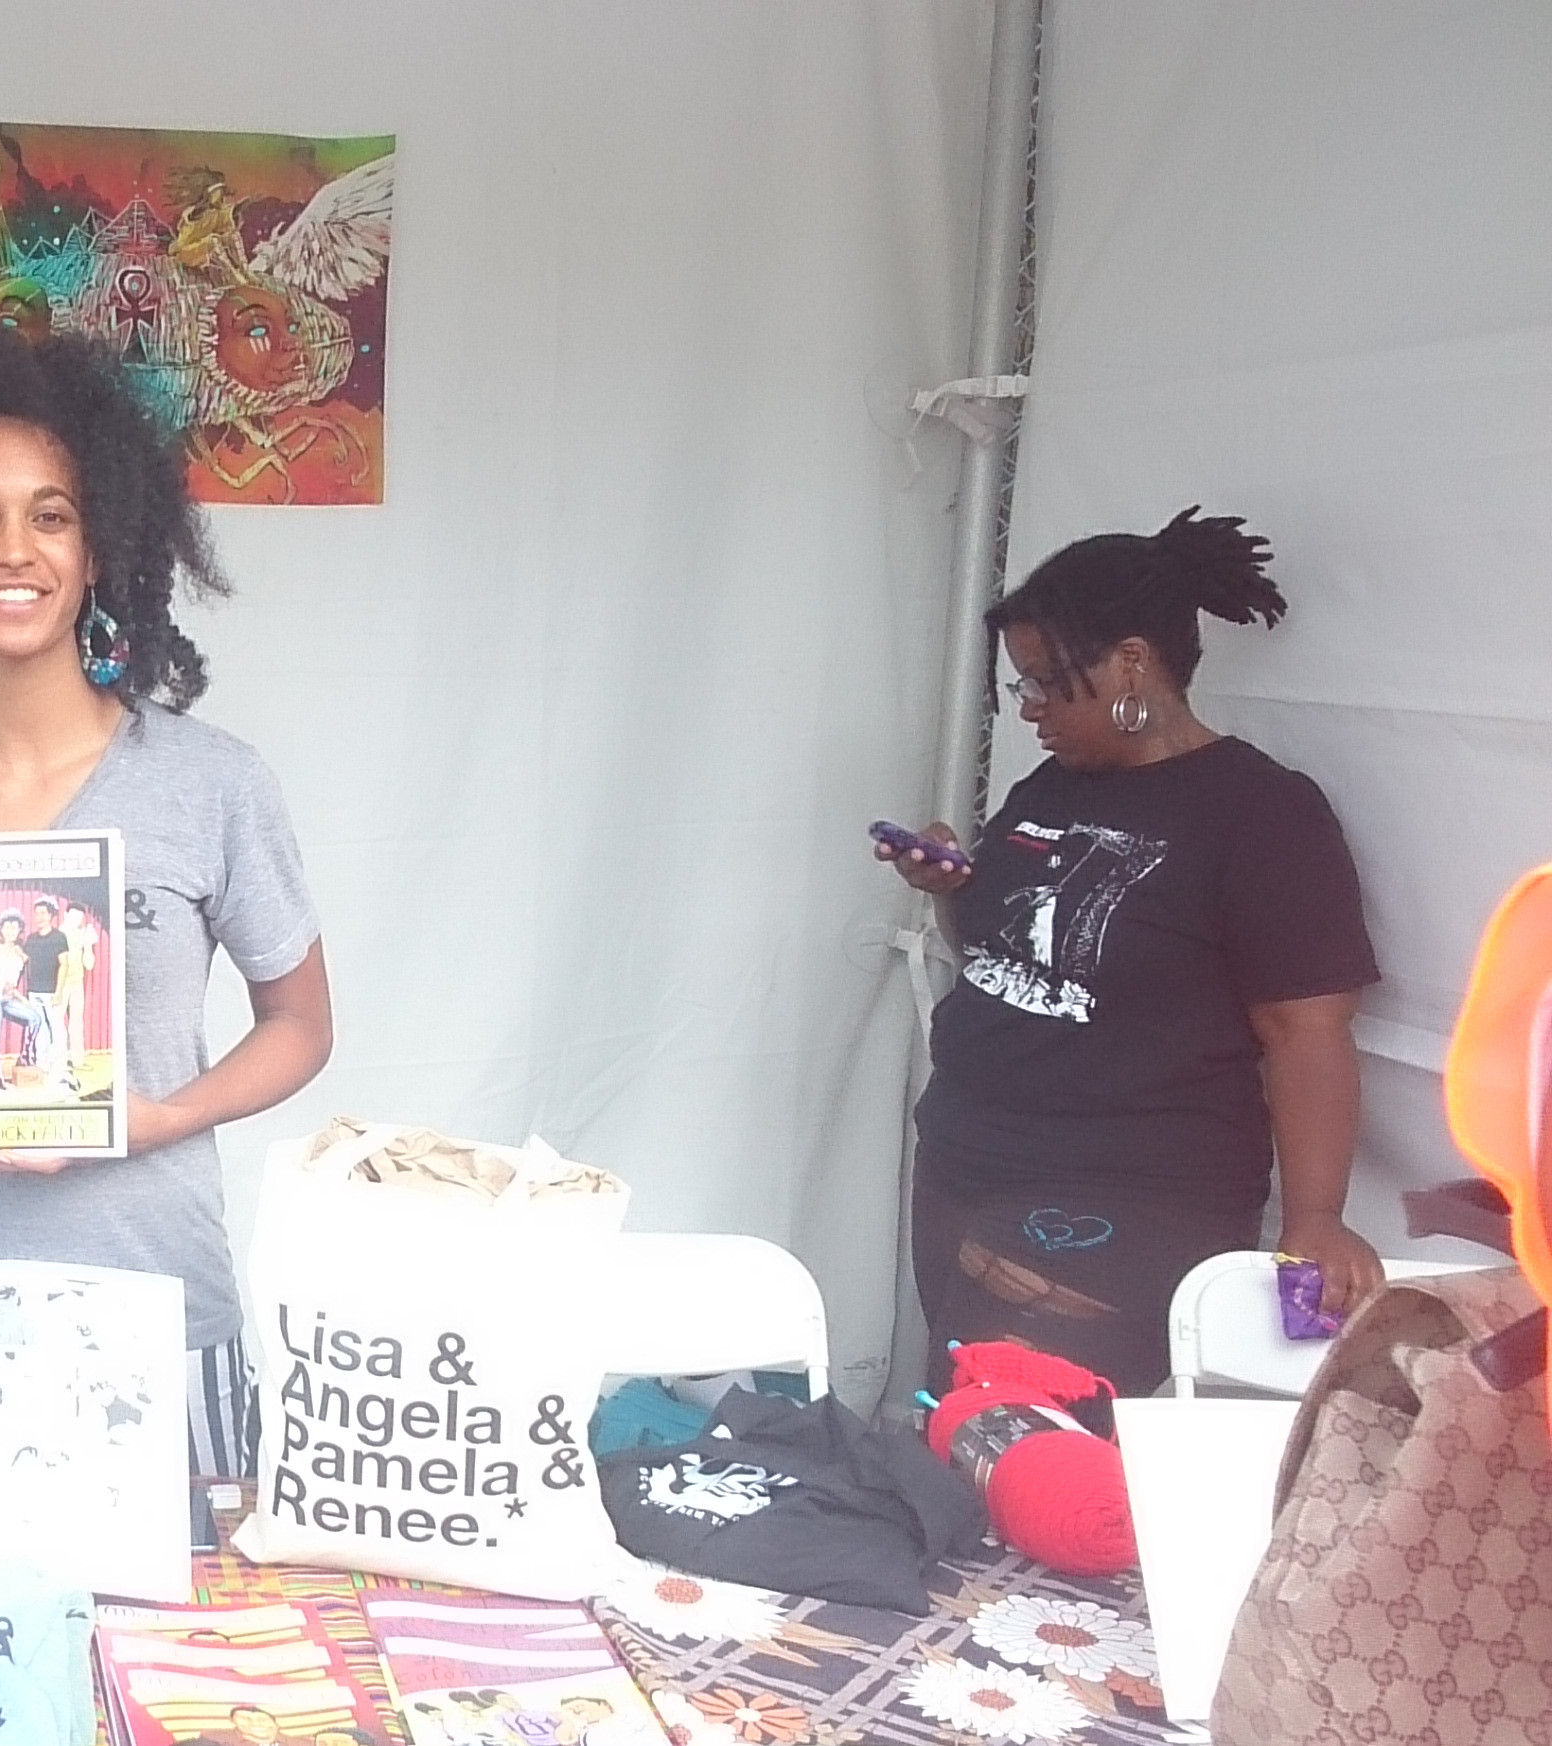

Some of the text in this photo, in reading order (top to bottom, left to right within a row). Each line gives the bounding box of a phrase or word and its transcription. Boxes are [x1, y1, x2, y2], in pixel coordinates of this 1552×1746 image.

[125, 889, 159, 932] &
[279, 1303, 477, 1386] Lisa &
[281, 1359, 576, 1447] Angela &
[281, 1414, 519, 1497] Pamela
[541, 1447, 586, 1490] &
